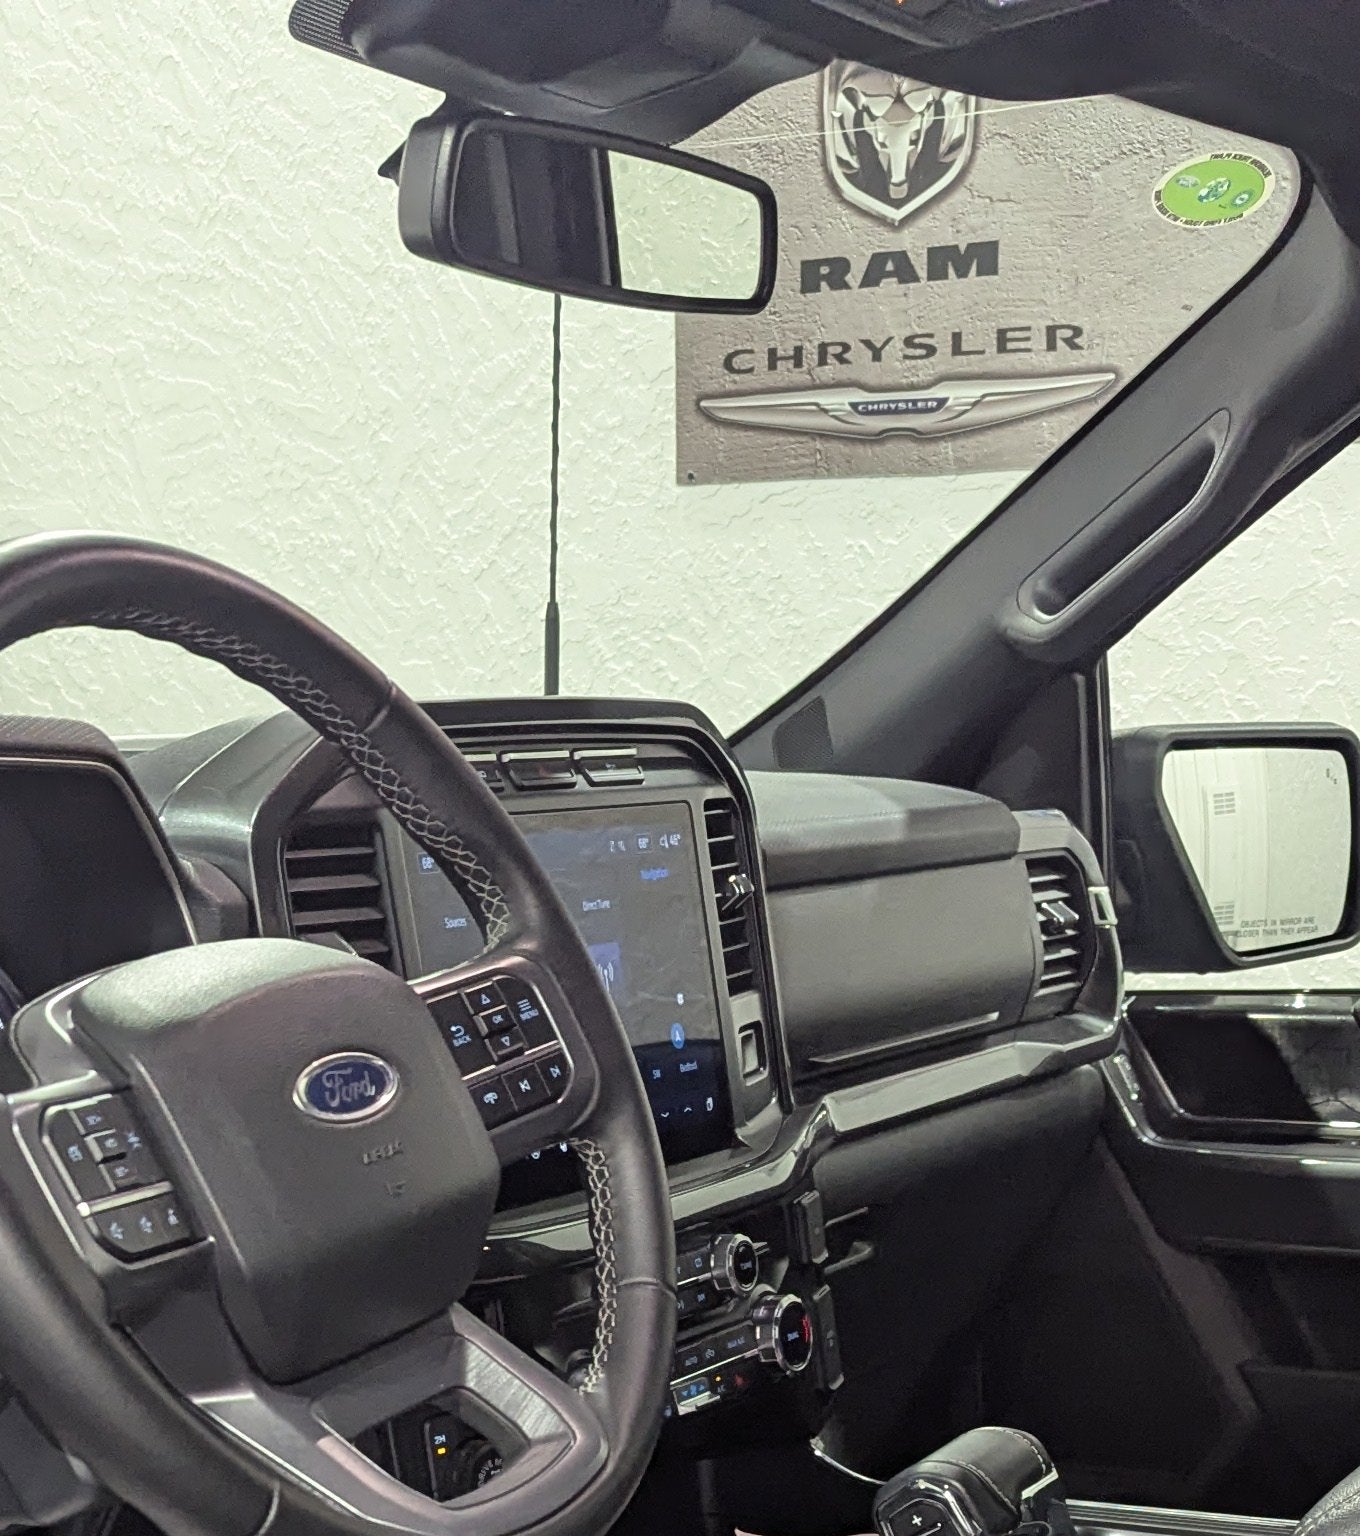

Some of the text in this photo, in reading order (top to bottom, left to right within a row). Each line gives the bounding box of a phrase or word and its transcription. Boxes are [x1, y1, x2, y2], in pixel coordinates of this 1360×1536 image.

[799, 239, 1000, 294] RAM
[723, 324, 1088, 374] CHRYSLER
[857, 401, 938, 412] CHRYSLER
[1279, 917, 1302, 926] MIRROR
[519, 1009, 539, 1021] MENU
[452, 1034, 472, 1048] BACK
[321, 1066, 376, 1108] Ford
[433, 1434, 447, 1445] 2H
